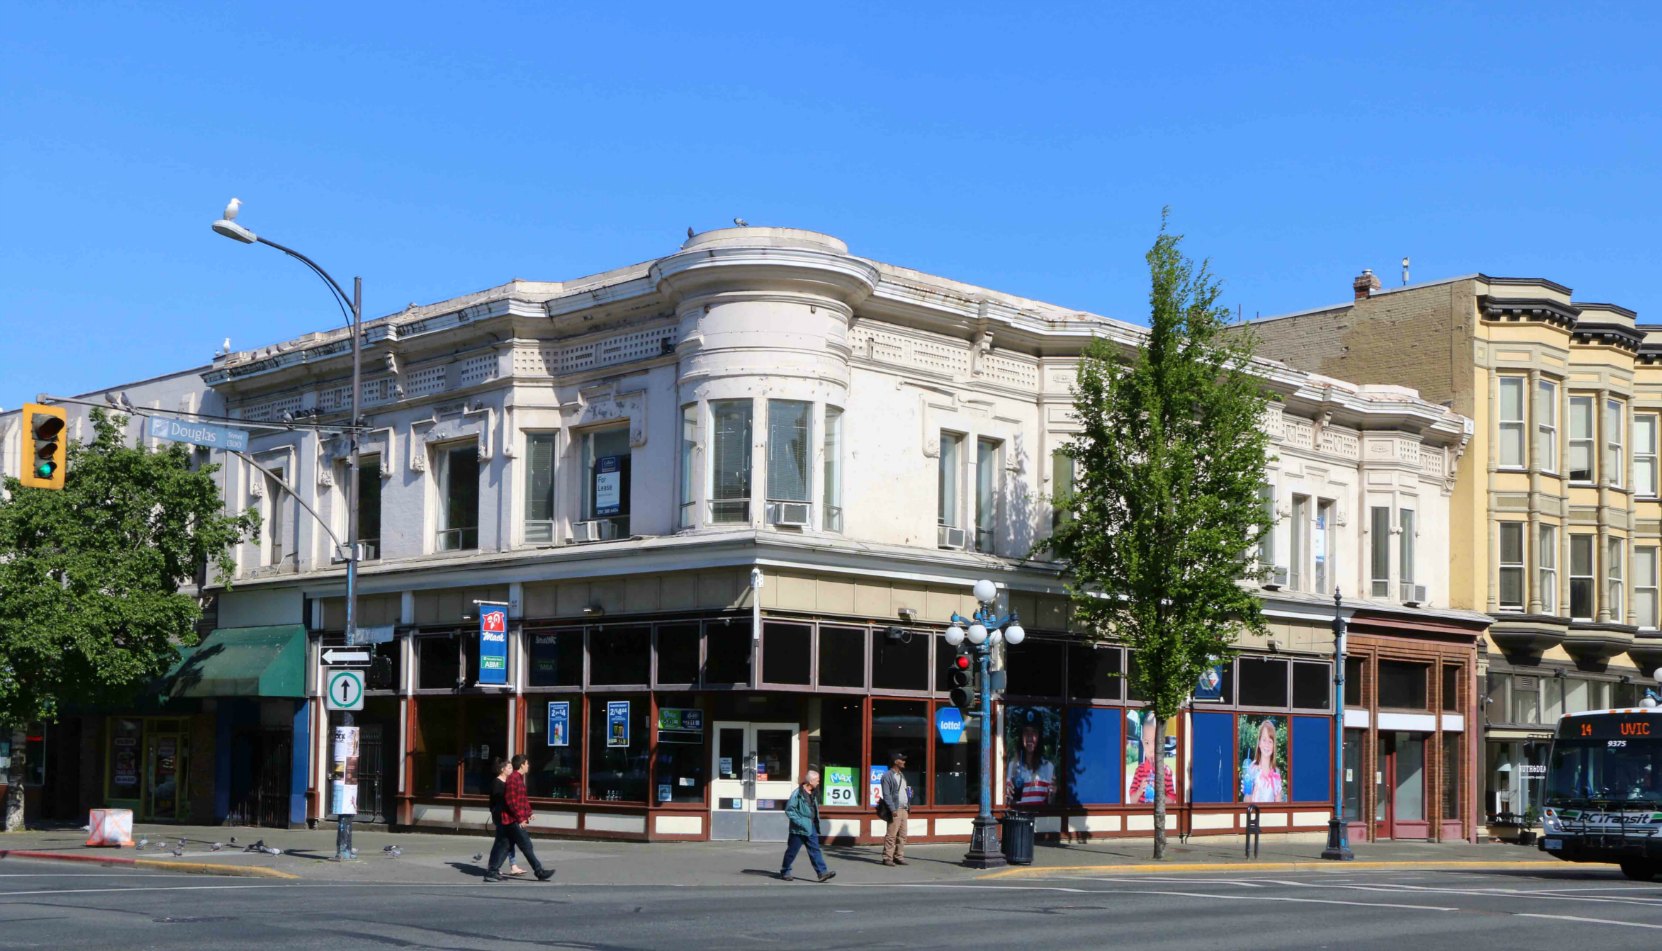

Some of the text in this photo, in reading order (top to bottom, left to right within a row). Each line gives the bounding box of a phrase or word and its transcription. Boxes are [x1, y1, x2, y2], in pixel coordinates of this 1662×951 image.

[171, 423, 216, 441] Douglas
[597, 475, 607, 484] For
[597, 484, 613, 492] Lease
[1581, 722, 1650, 736] 14 UVIC
